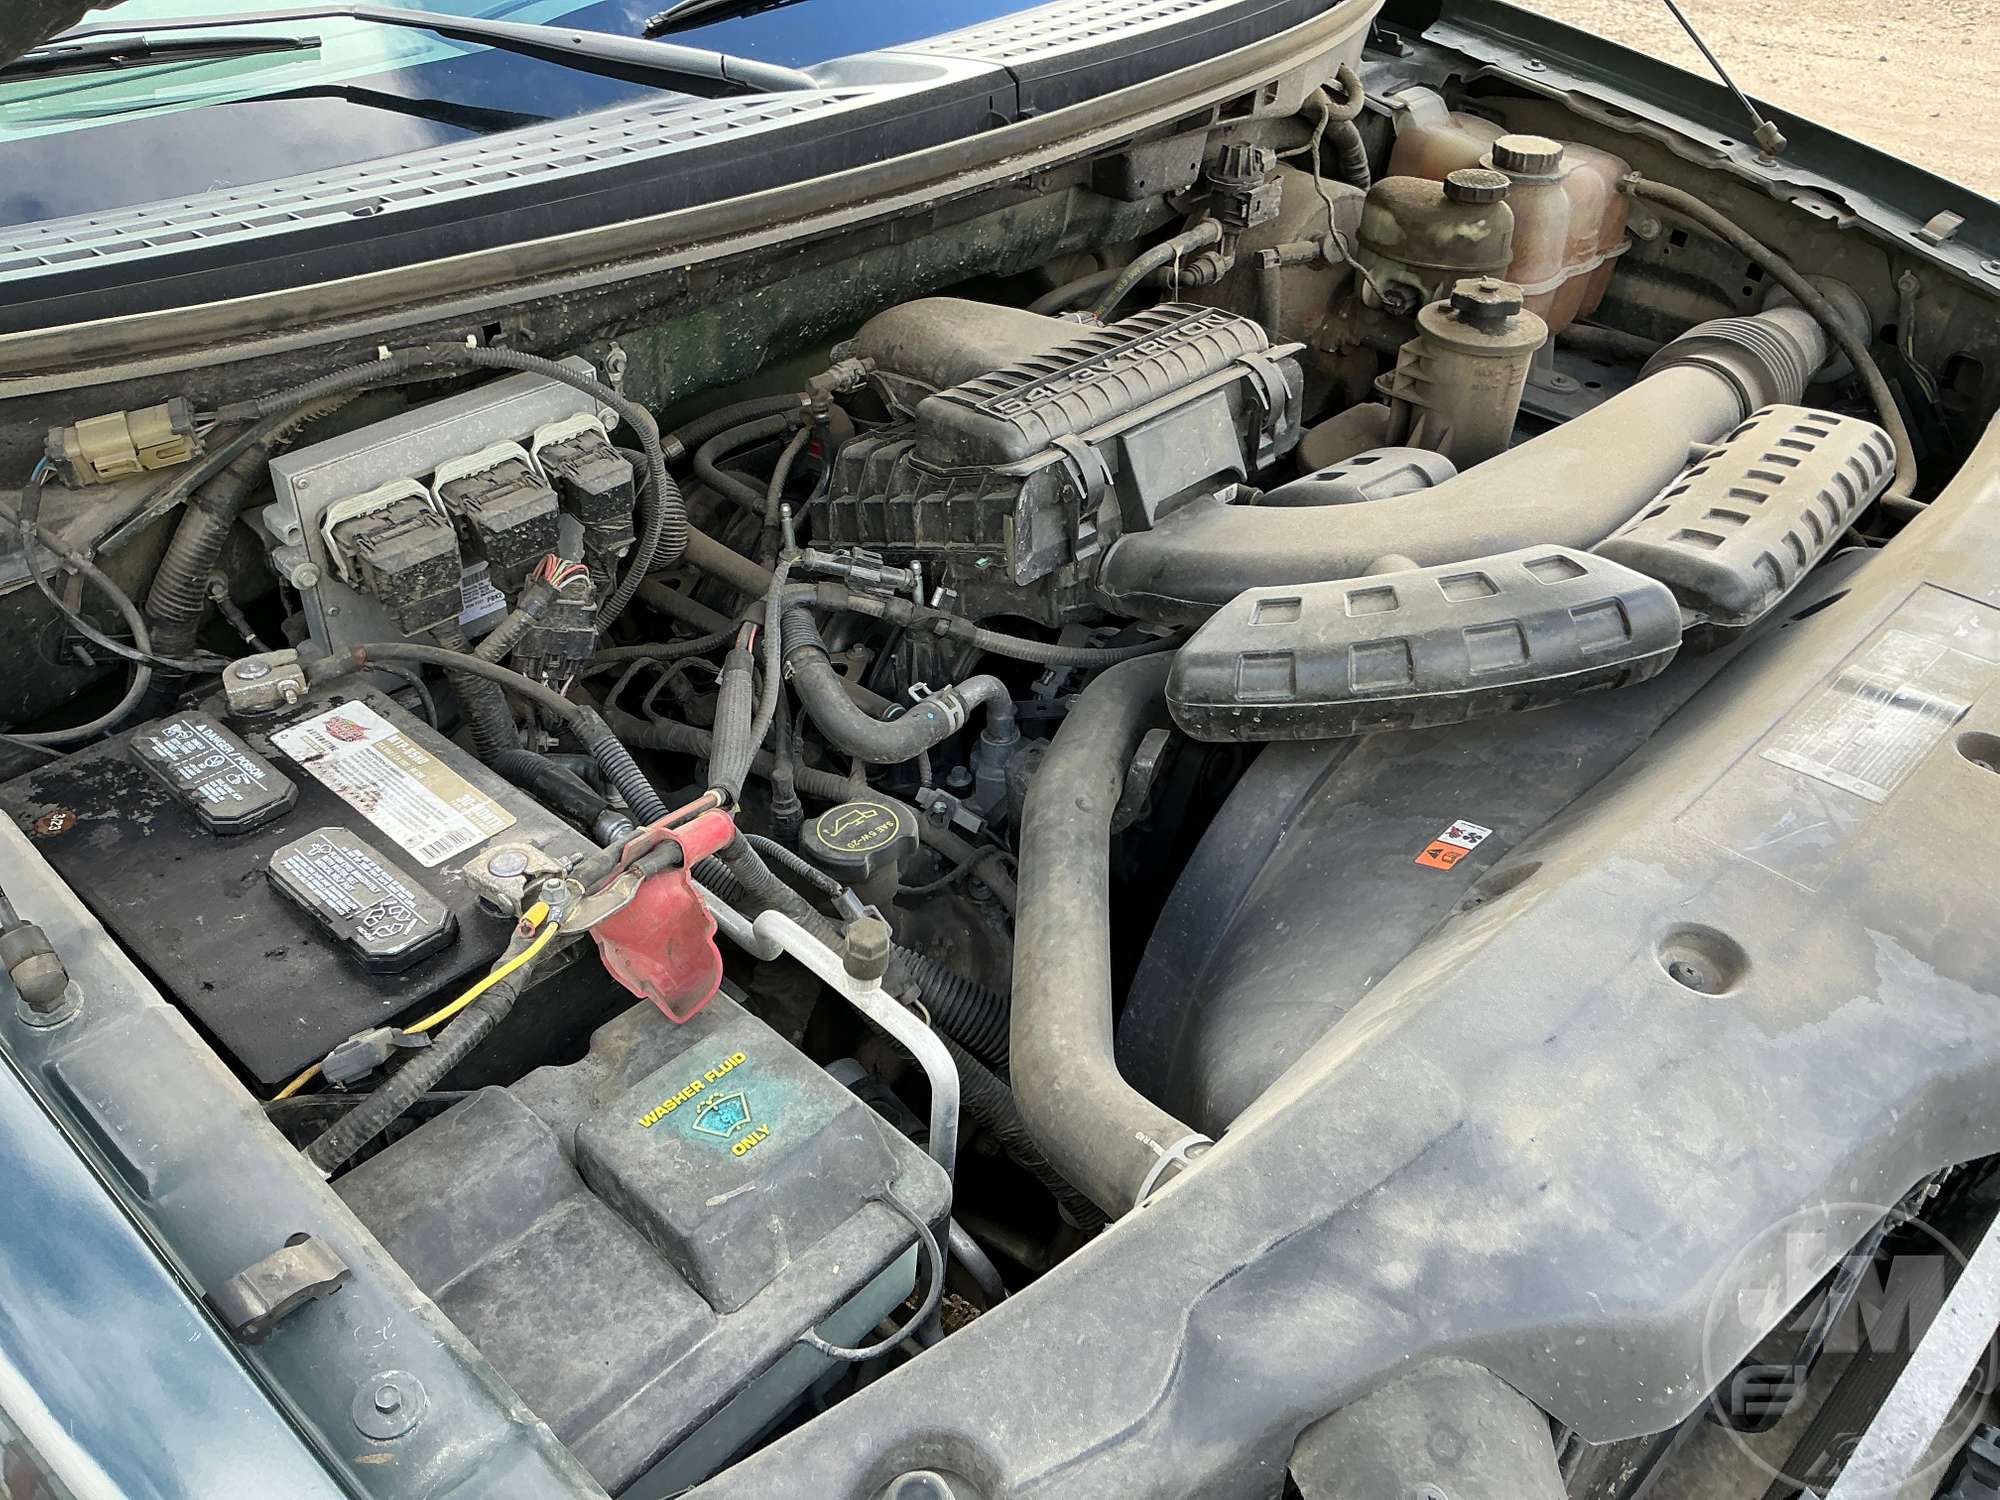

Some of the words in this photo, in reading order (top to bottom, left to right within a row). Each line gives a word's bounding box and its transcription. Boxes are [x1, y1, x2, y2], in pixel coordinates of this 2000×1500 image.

[1115, 313, 1228, 361] TRITON
[201, 729, 235, 753] DANGER
[235, 755, 266, 780] POISON
[847, 831, 878, 849] 5W-20
[875, 821, 894, 833] SAE
[639, 1080, 706, 1128] WASHER
[704, 1051, 748, 1084] FLUID
[731, 1123, 772, 1157] ONLY
